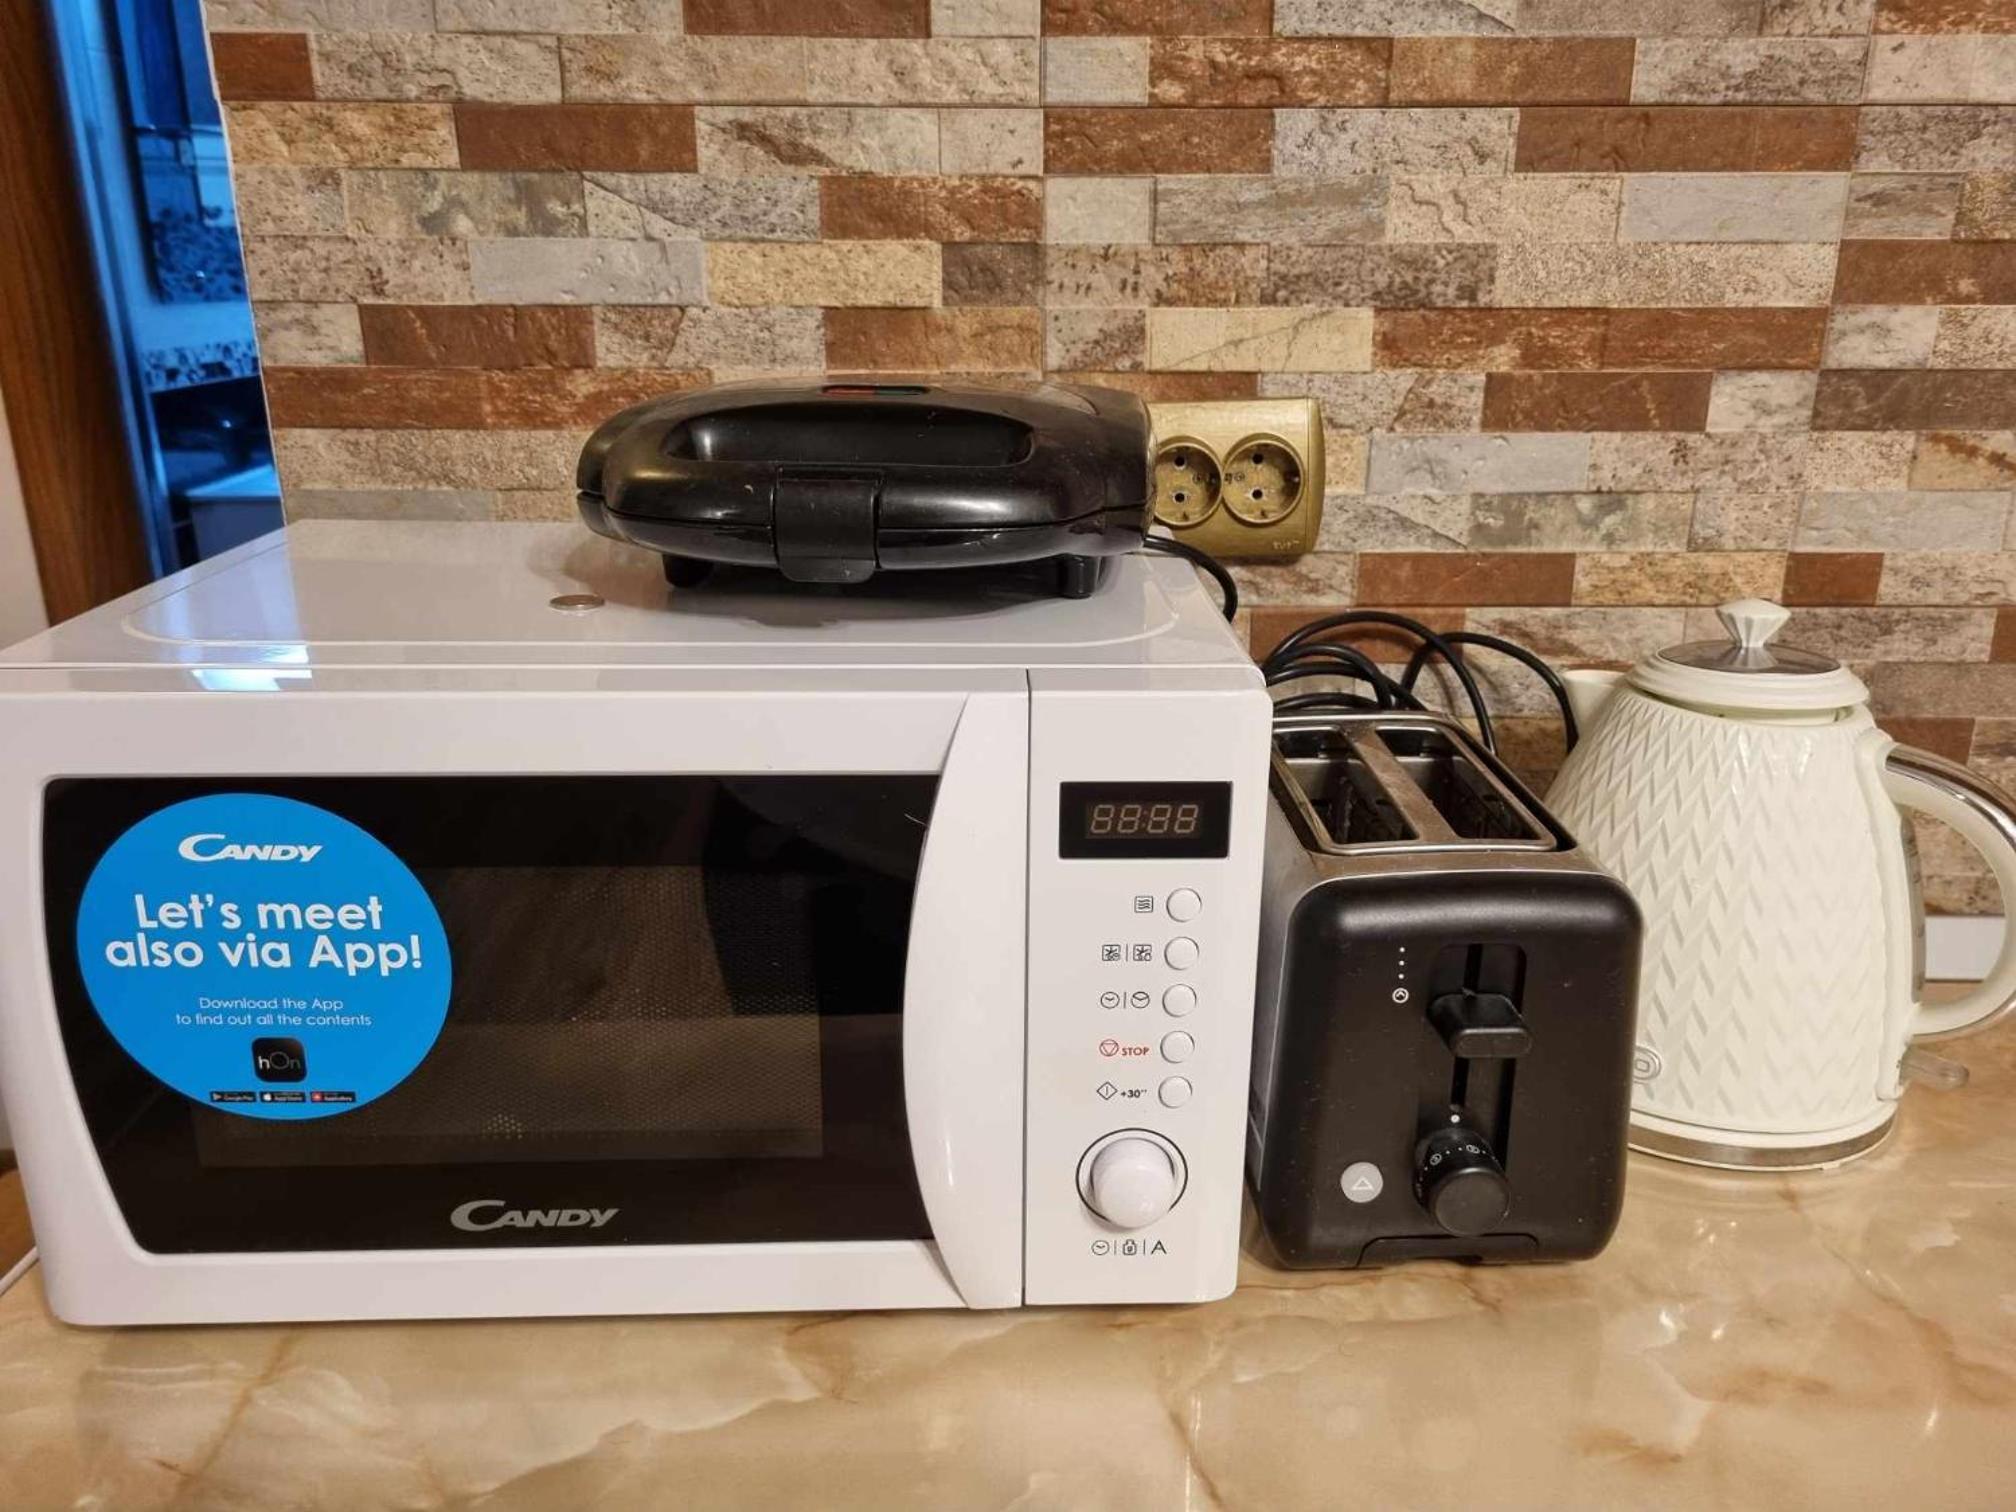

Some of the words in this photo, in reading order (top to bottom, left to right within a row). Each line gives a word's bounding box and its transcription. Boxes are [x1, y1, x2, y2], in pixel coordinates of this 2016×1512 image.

[178, 833, 322, 862] CANDY
[135, 894, 242, 929] Let's
[257, 896, 382, 930] meet
[105, 932, 204, 967] also
[218, 932, 291, 967] via
[309, 934, 422, 976] App!
[199, 997, 278, 1009] Download
[283, 997, 307, 1009] the
[312, 998, 344, 1012] App
[176, 1014, 192, 1025] to
[196, 1014, 223, 1025] find
[227, 1014, 252, 1025] out
[257, 1014, 273, 1025] all
[277, 1014, 302, 1025] the
[306, 1014, 372, 1026] contents
[1121, 1046, 1150, 1056] STOP
[450, 1200, 620, 1232] CANDY
[1151, 1239, 1167, 1255] A
